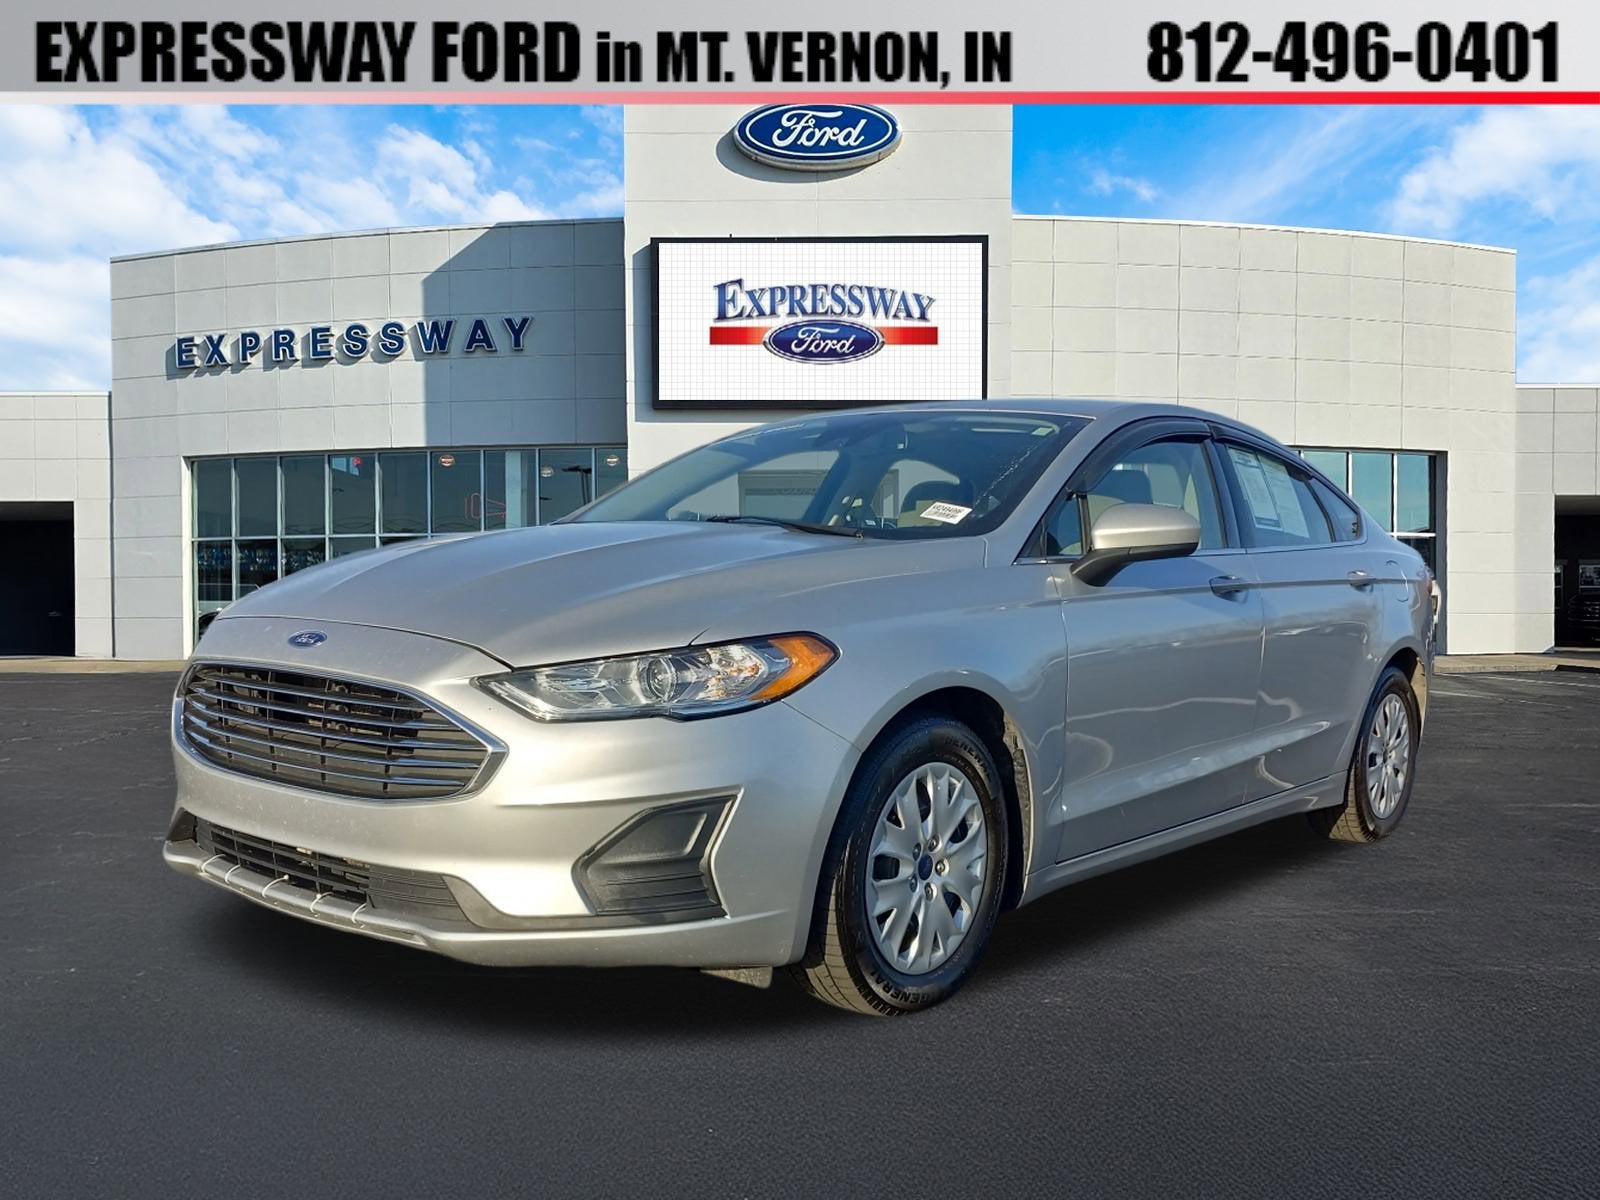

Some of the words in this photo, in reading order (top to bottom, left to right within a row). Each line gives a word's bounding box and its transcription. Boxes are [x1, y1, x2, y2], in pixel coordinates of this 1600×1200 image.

[771, 109, 868, 148] Ford
[713, 278, 936, 322] EXPRESSWAY
[175, 316, 534, 369] EXPRESSWAY
[790, 326, 856, 354] Ford
